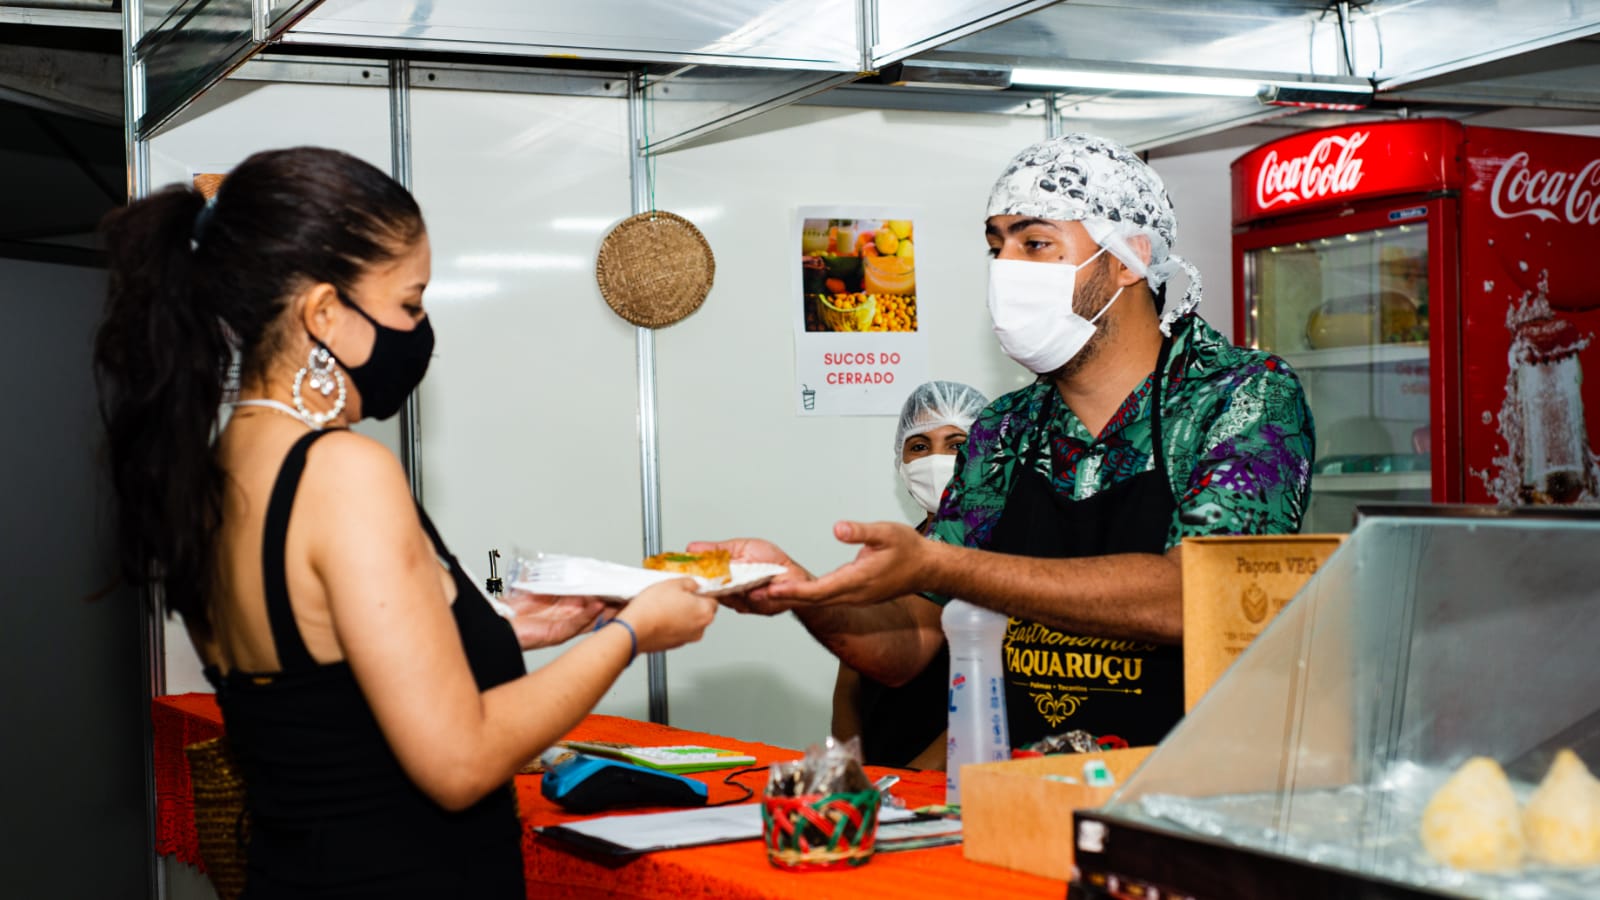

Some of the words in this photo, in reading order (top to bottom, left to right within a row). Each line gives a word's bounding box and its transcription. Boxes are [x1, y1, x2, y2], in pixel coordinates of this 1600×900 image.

[824, 352, 876, 365] SUCOS
[880, 352, 901, 365] DO
[826, 372, 895, 385] CERRADO
[1005, 647, 1143, 685] TAQUARUÇU
